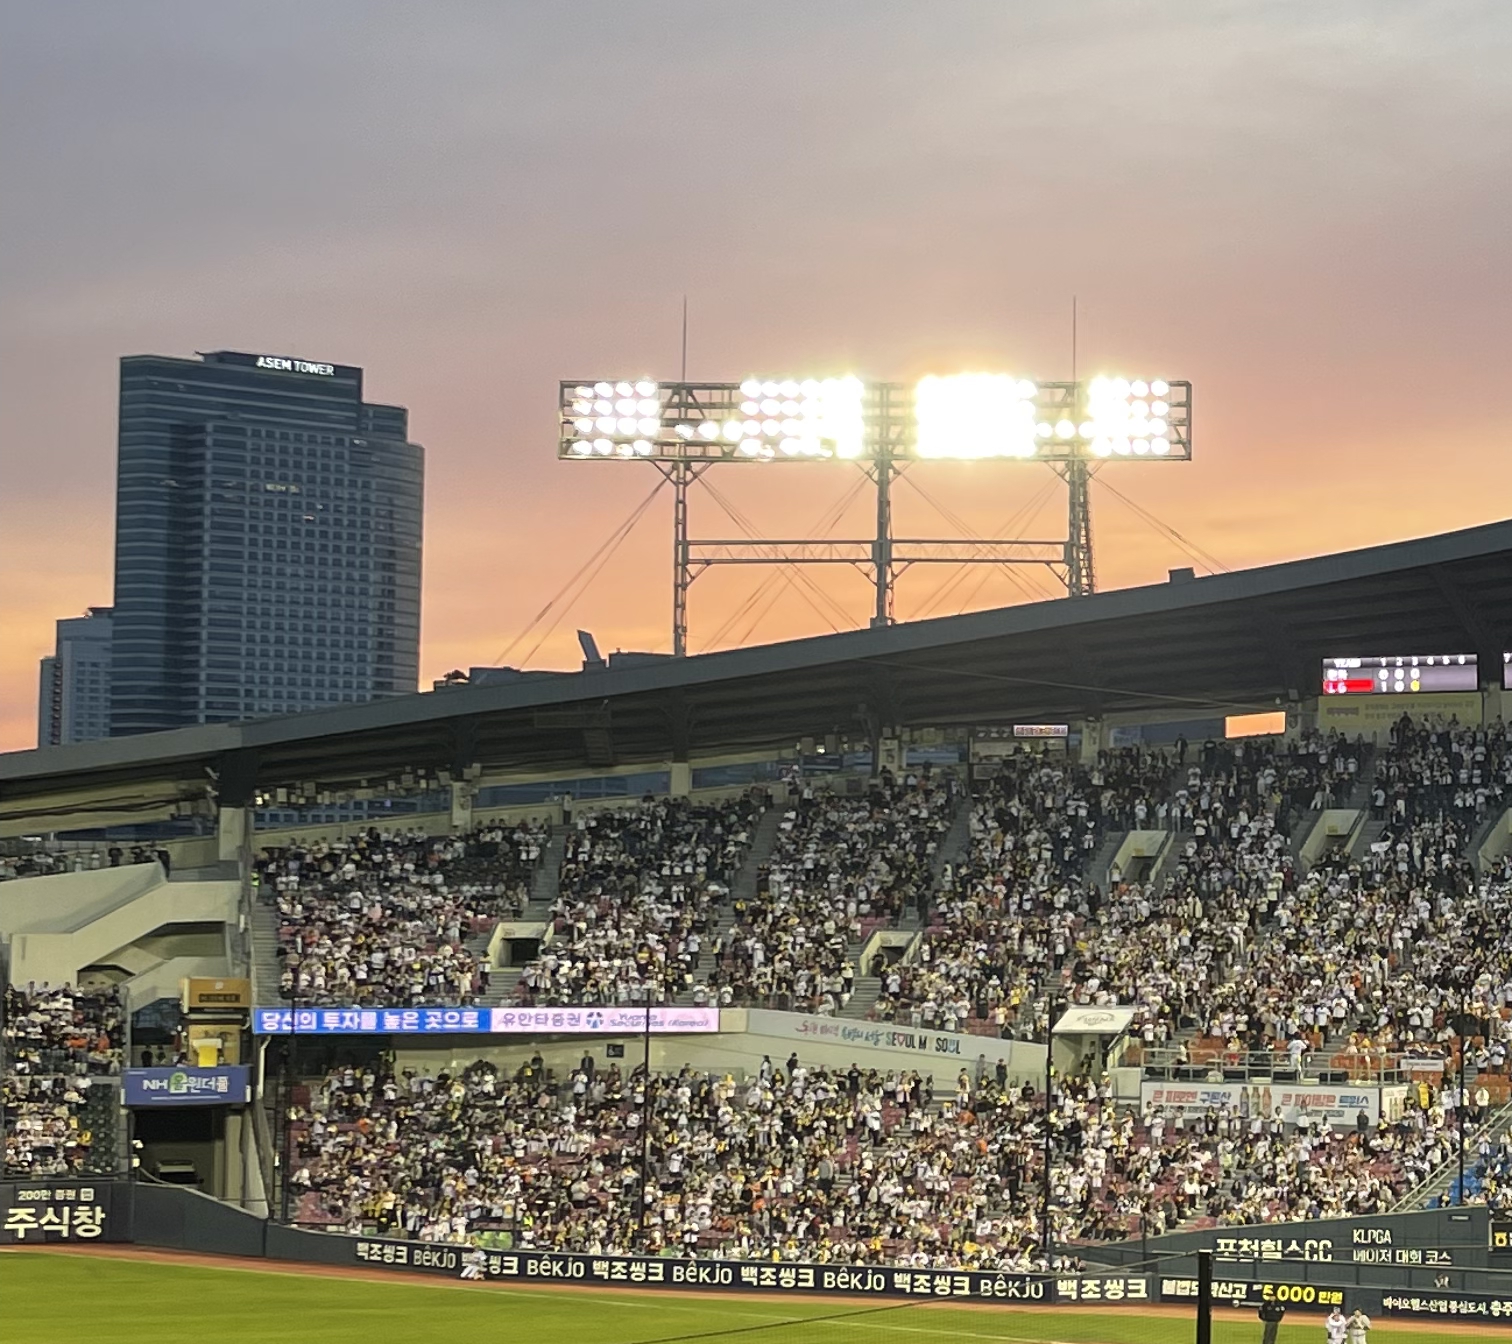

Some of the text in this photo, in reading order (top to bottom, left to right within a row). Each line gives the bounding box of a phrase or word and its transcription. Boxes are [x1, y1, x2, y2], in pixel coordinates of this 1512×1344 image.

[256, 356, 334, 376] ASEM TOWER
[262, 1011, 317, 1030] 당신의
[383, 1011, 420, 1030] 높은
[424, 1011, 479, 1029] 곳으로
[501, 1012, 582, 1027] 유안타증권
[143, 1079, 168, 1090] NH
[4, 1206, 106, 1239] 주식창
[1352, 1228, 1392, 1245] KLPGA
[1396, 1248, 1422, 1265] 대회
[1425, 1249, 1453, 1265] 코스
[357, 1242, 408, 1264] 백조씽크
[592, 1260, 664, 1282] 백조씽크
[741, 1264, 815, 1288] 백조씽크
[893, 1271, 972, 1296] 백조씽크
[1057, 1277, 1149, 1301] 백조씽크
